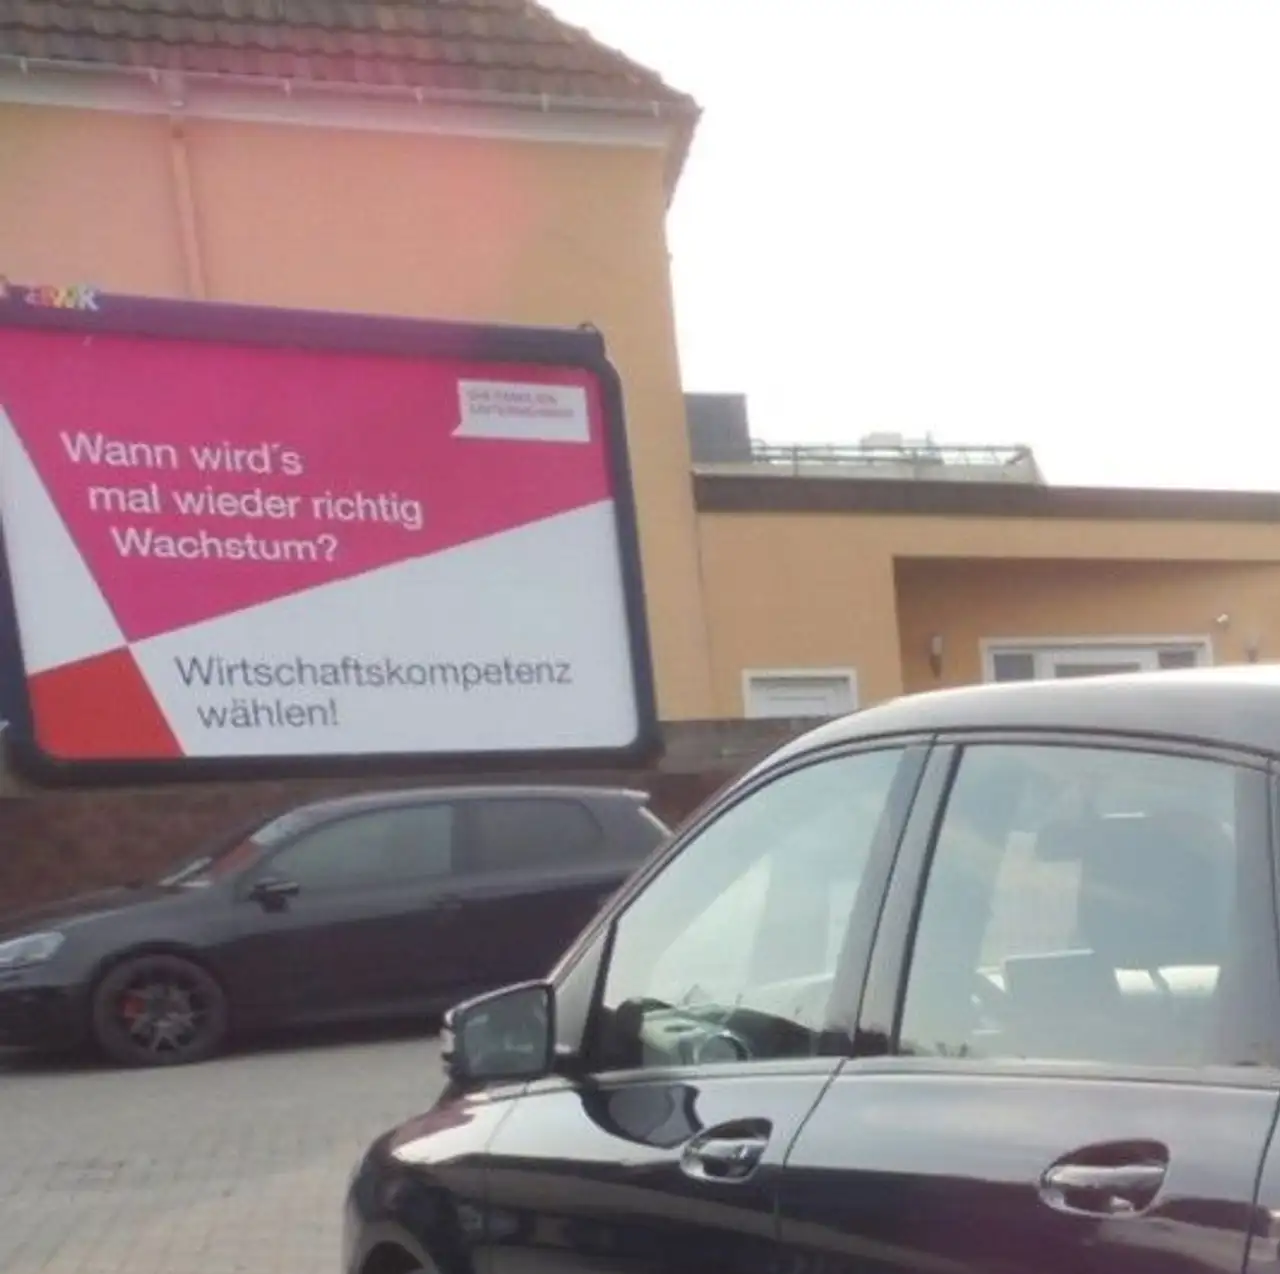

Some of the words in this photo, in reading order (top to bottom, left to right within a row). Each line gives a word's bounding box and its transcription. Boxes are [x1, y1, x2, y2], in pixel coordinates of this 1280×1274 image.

[61, 432, 178, 471] Wann
[89, 484, 159, 514] mal
[172, 490, 301, 519] wieder
[312, 494, 423, 530] richtig
[111, 526, 337, 562] Wachstum?
[174, 655, 572, 692] Wirtschaftskompetenz
[197, 698, 339, 729] wählen!
